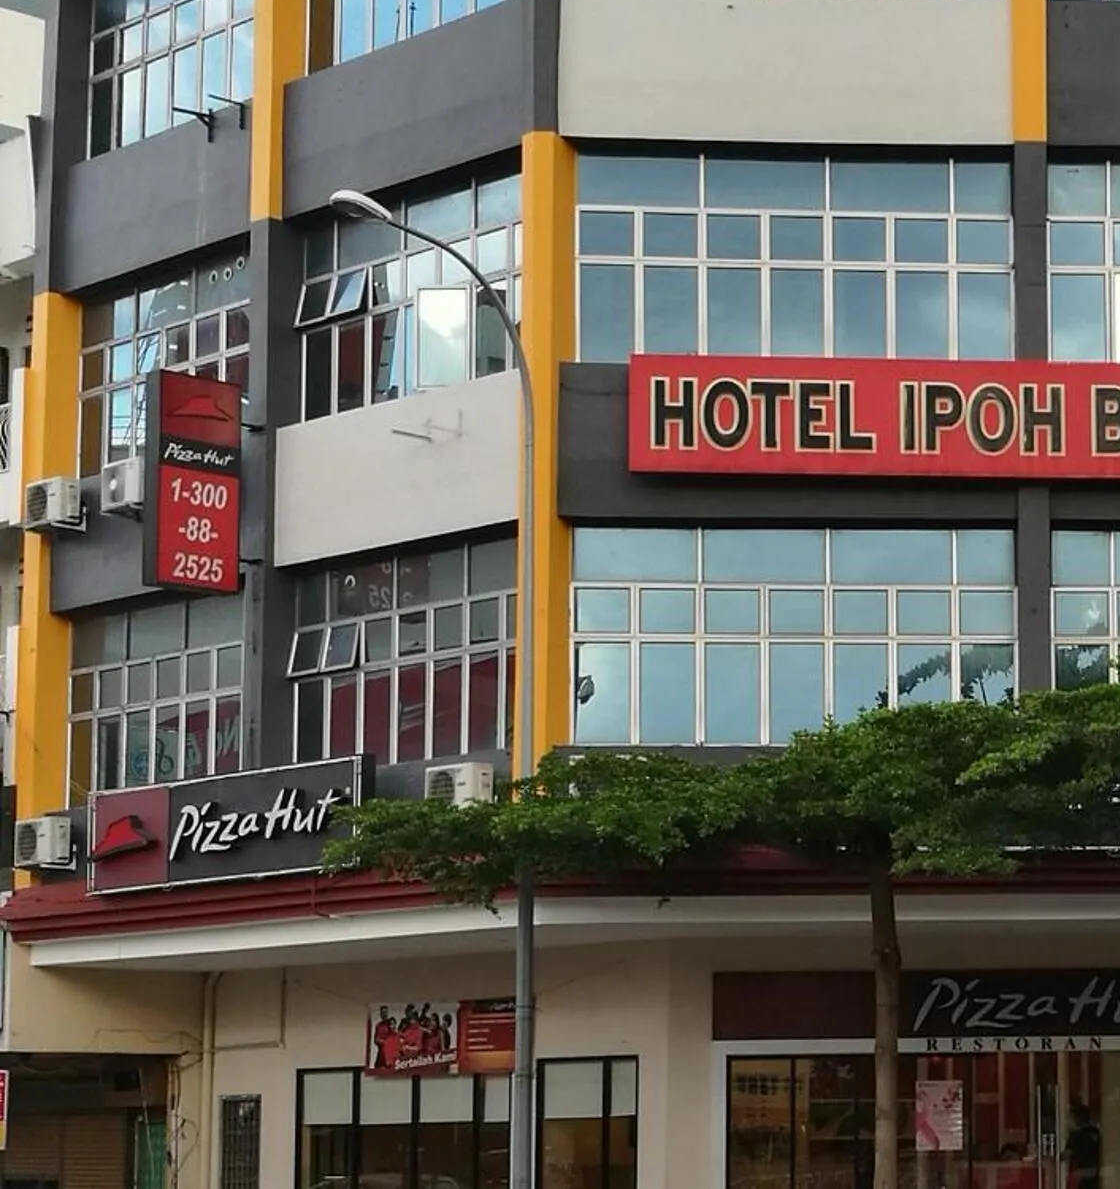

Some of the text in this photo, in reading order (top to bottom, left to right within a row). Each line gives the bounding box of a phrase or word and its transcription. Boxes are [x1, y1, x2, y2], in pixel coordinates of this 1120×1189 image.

[649, 376, 876, 452] HOTEL
[899, 380, 1066, 457] IPOH
[164, 443, 234, 467] Pizza Hut
[171, 477, 228, 510] 1-300
[178, 516, 219, 544] -88-
[172, 552, 223, 583] 2525
[169, 787, 341, 861] Pizza Hut
[912, 976, 1060, 1032] Pizza
[926, 1036, 1103, 1053] RESTORAN
